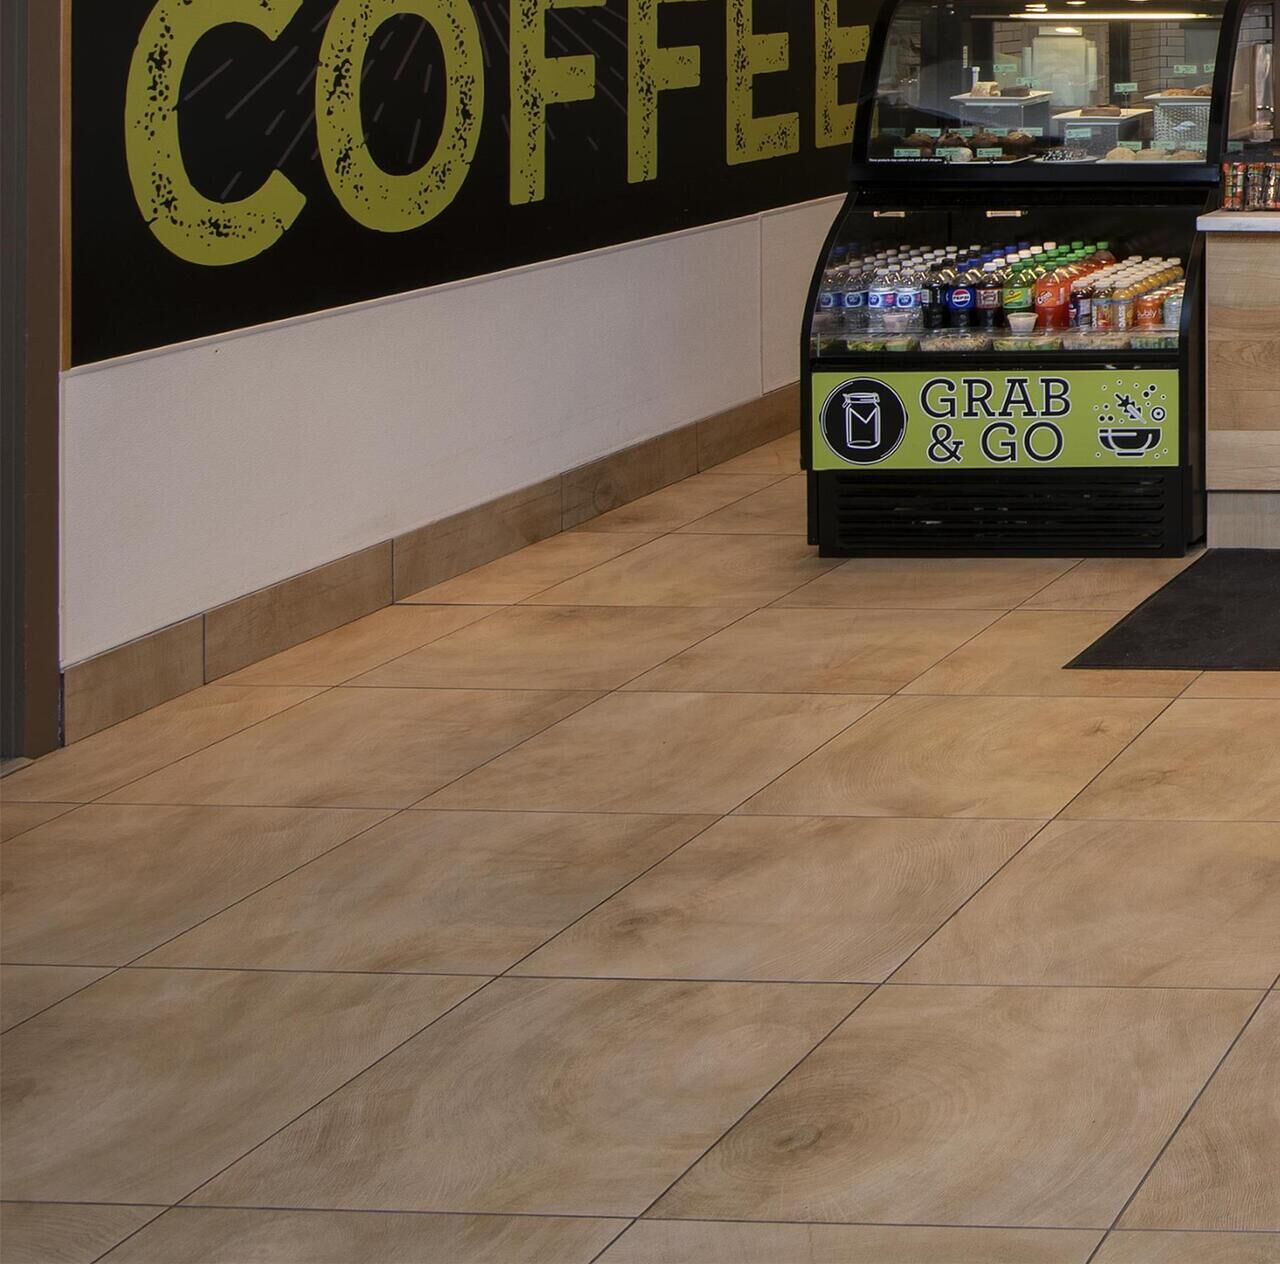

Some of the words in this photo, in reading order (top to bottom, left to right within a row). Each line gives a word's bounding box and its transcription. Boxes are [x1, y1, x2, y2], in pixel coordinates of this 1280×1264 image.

[920, 377, 1071, 418] GRAB
[926, 421, 963, 463] &
[981, 421, 1064, 463] GO
